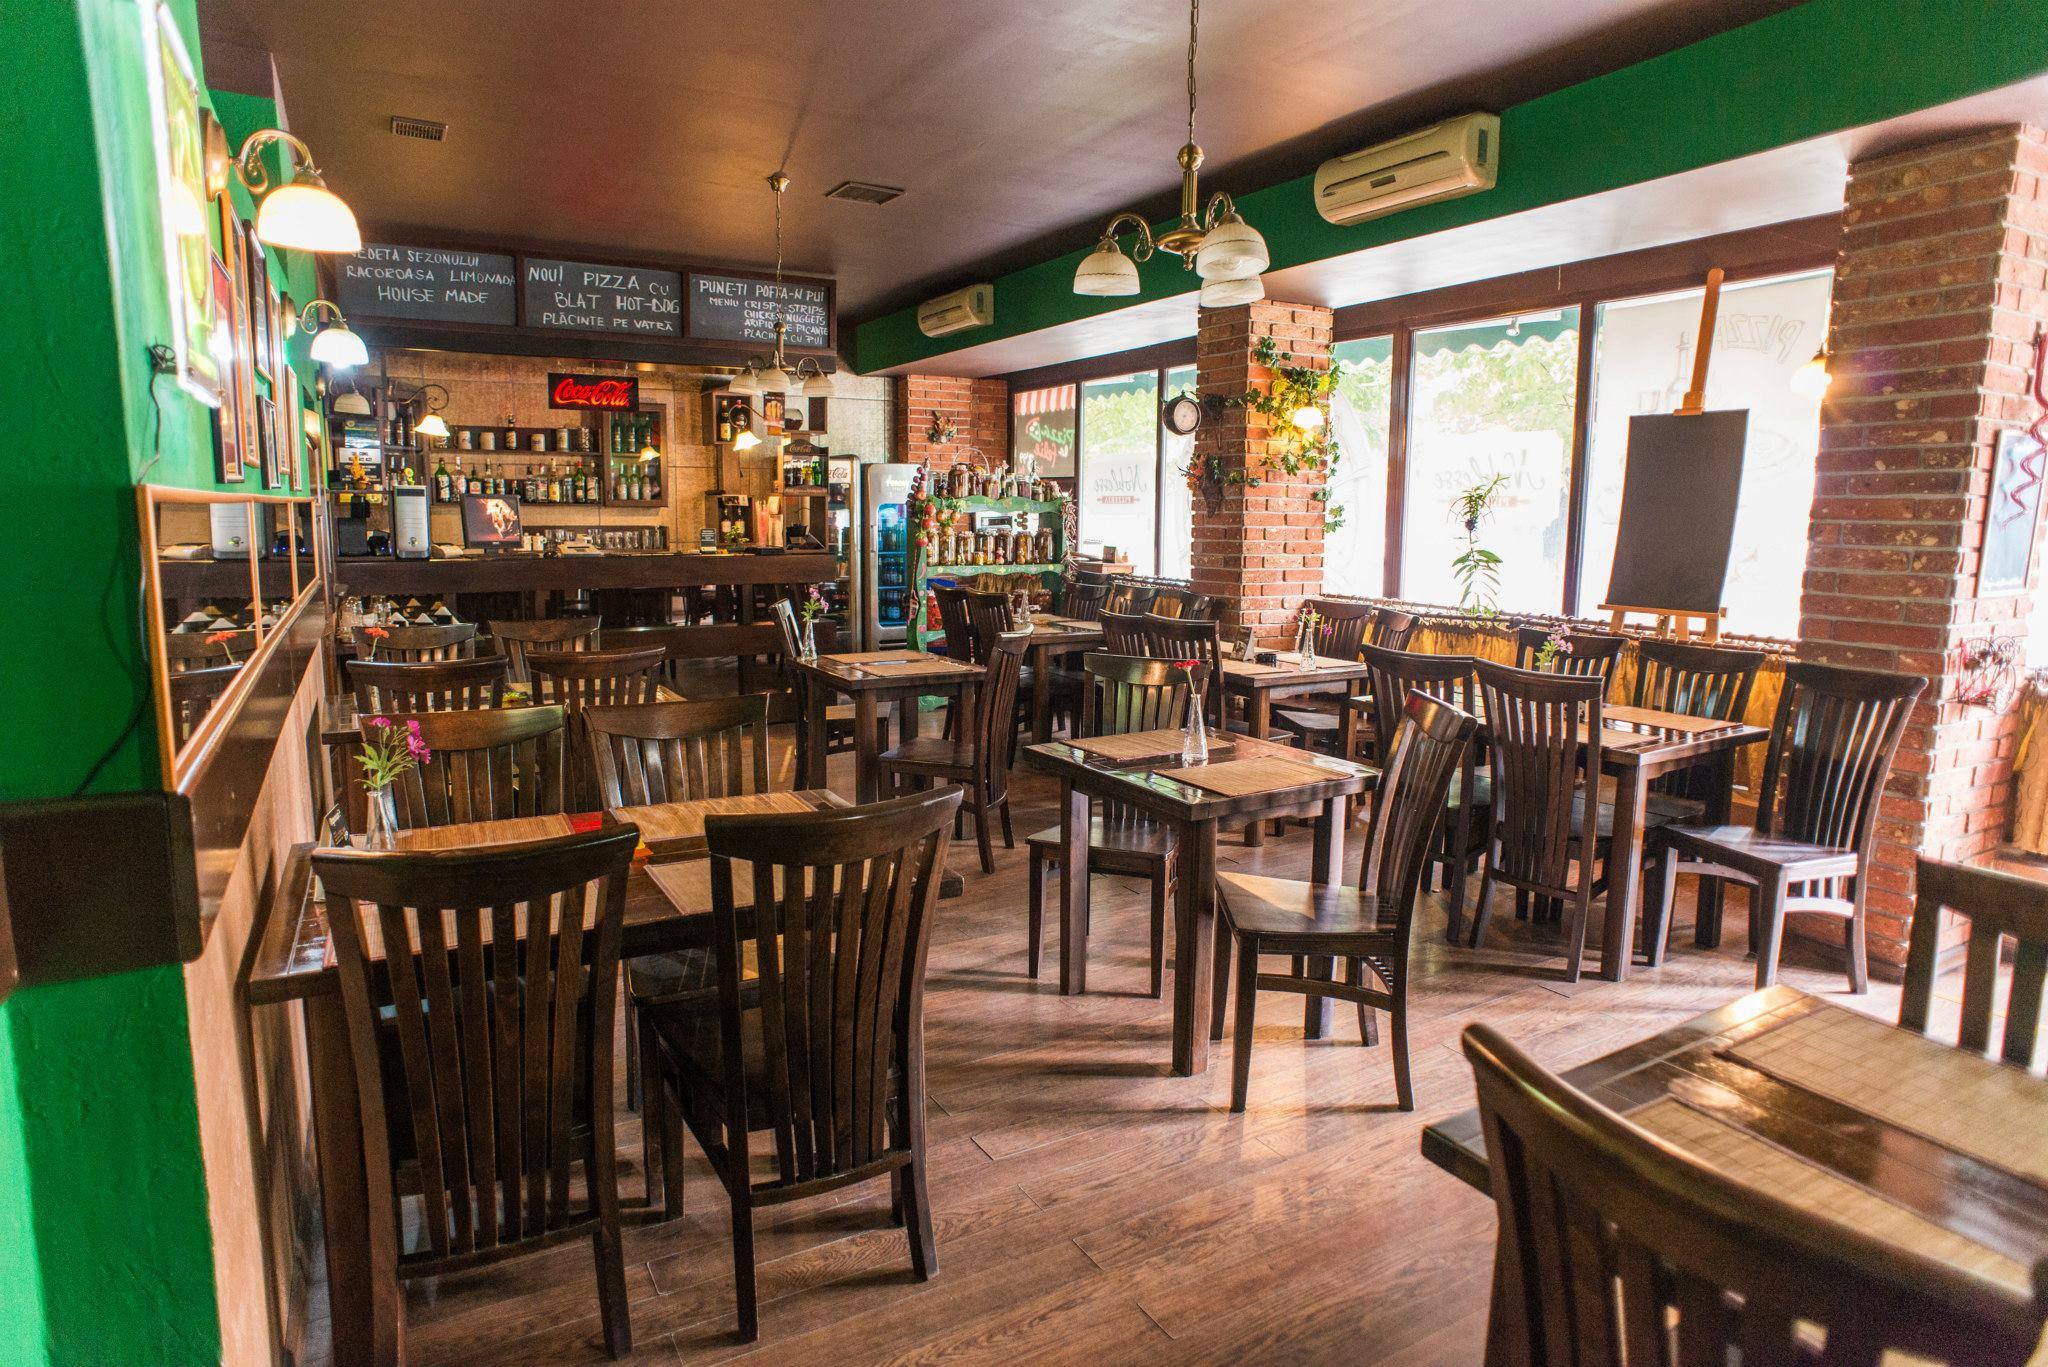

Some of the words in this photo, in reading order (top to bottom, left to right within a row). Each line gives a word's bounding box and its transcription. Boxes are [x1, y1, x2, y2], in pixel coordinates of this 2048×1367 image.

[408, 250, 479, 267] SEZONULUI
[346, 265, 434, 281] RACOROASA
[450, 270, 515, 286] LIMONADA
[528, 265, 563, 286] NOU!
[583, 271, 640, 290] PIZZA
[649, 282, 669, 296] CU
[378, 285, 434, 303] HOUSE
[445, 290, 489, 304] MADE
[699, 279, 747, 297] PUNE-TI
[554, 291, 602, 310] BLAT
[616, 295, 680, 314] HOT-DOG
[709, 296, 739, 307] MENIU
[613, 318, 629, 328] PE
[786, 313, 826, 326] NUGGETS
[796, 323, 829, 336] PICANTE
[790, 334, 803, 343] CU
[805, 335, 823, 345] PUI
[553, 378, 634, 407] Coca-Cola
